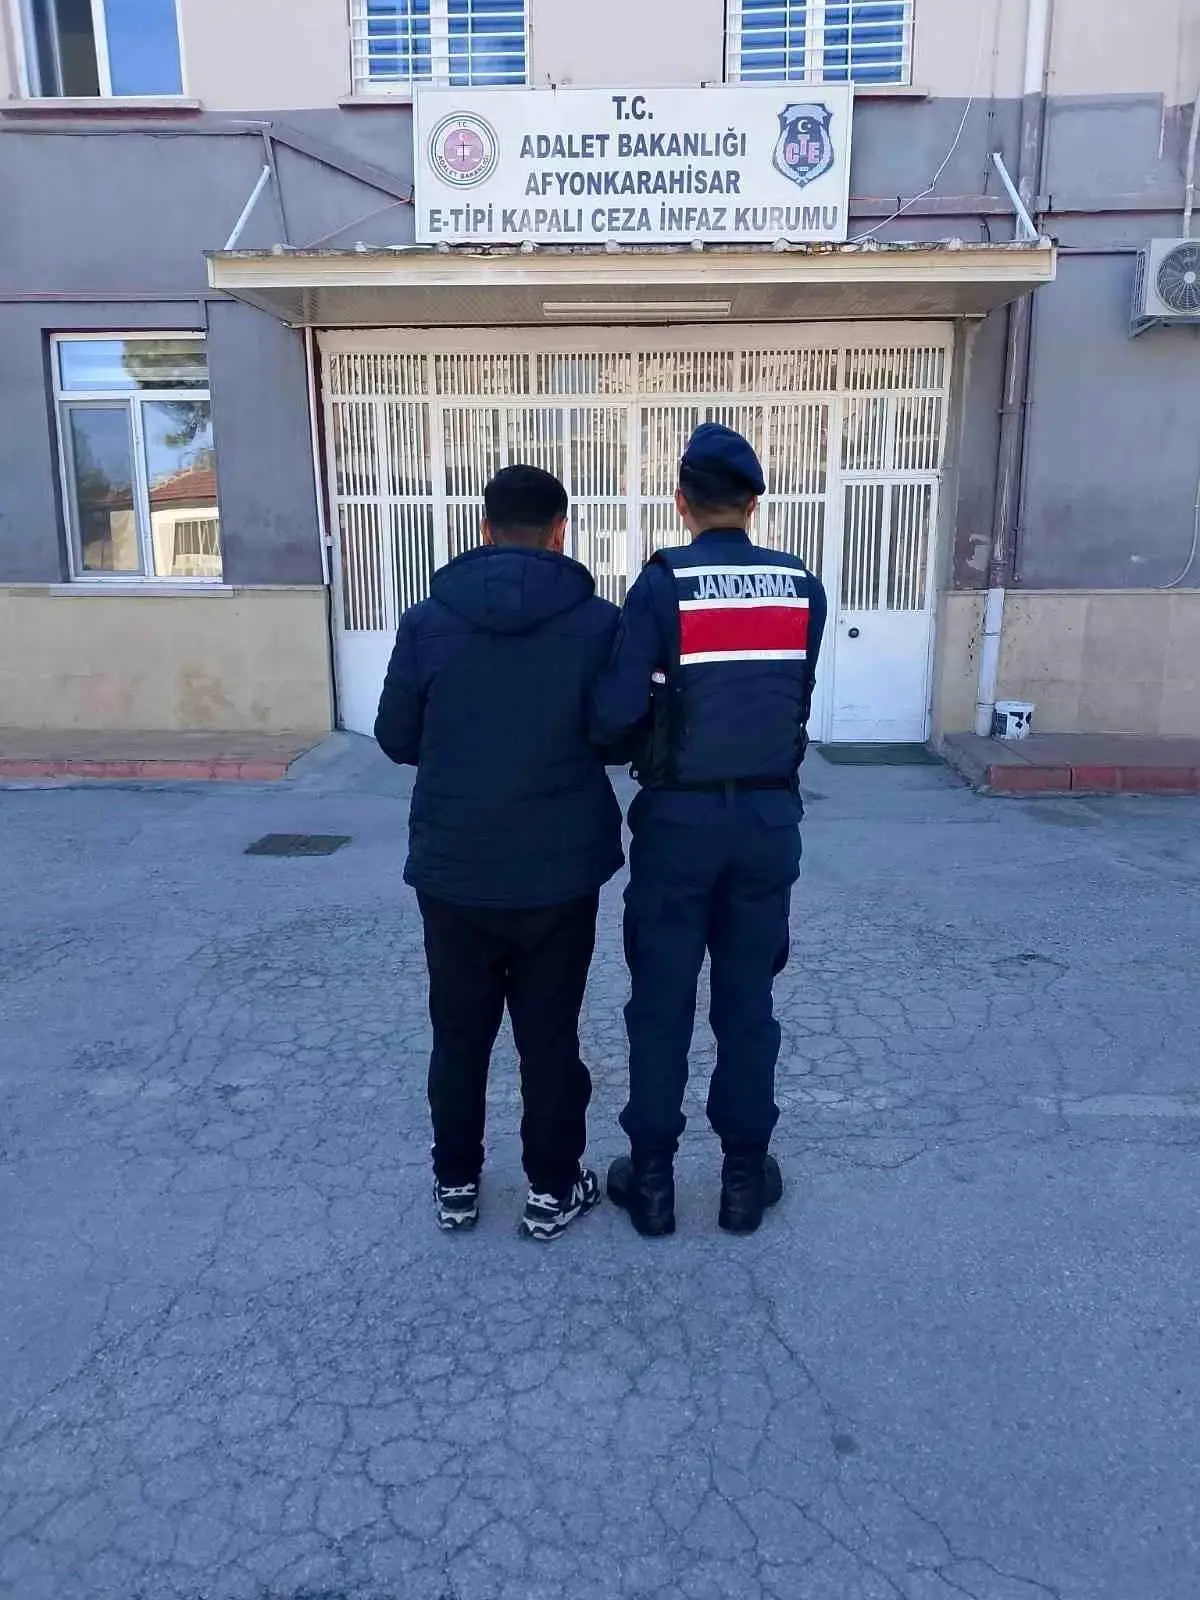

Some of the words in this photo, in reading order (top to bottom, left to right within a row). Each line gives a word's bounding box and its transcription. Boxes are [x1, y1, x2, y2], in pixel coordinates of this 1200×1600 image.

[612, 95, 654, 121] T.C.
[520, 133, 610, 159] ADALET
[618, 127, 747, 157] BAKANLIĞI
[525, 164, 741, 196] AFYONKARAHİSAR
[429, 203, 493, 233] E-TİPİ
[502, 208, 583, 233] KAPALI
[591, 207, 651, 232] CEZA
[660, 201, 727, 231] İNFAZ
[734, 206, 838, 231] KURUMU
[693, 574, 798, 600] JANDARMA
